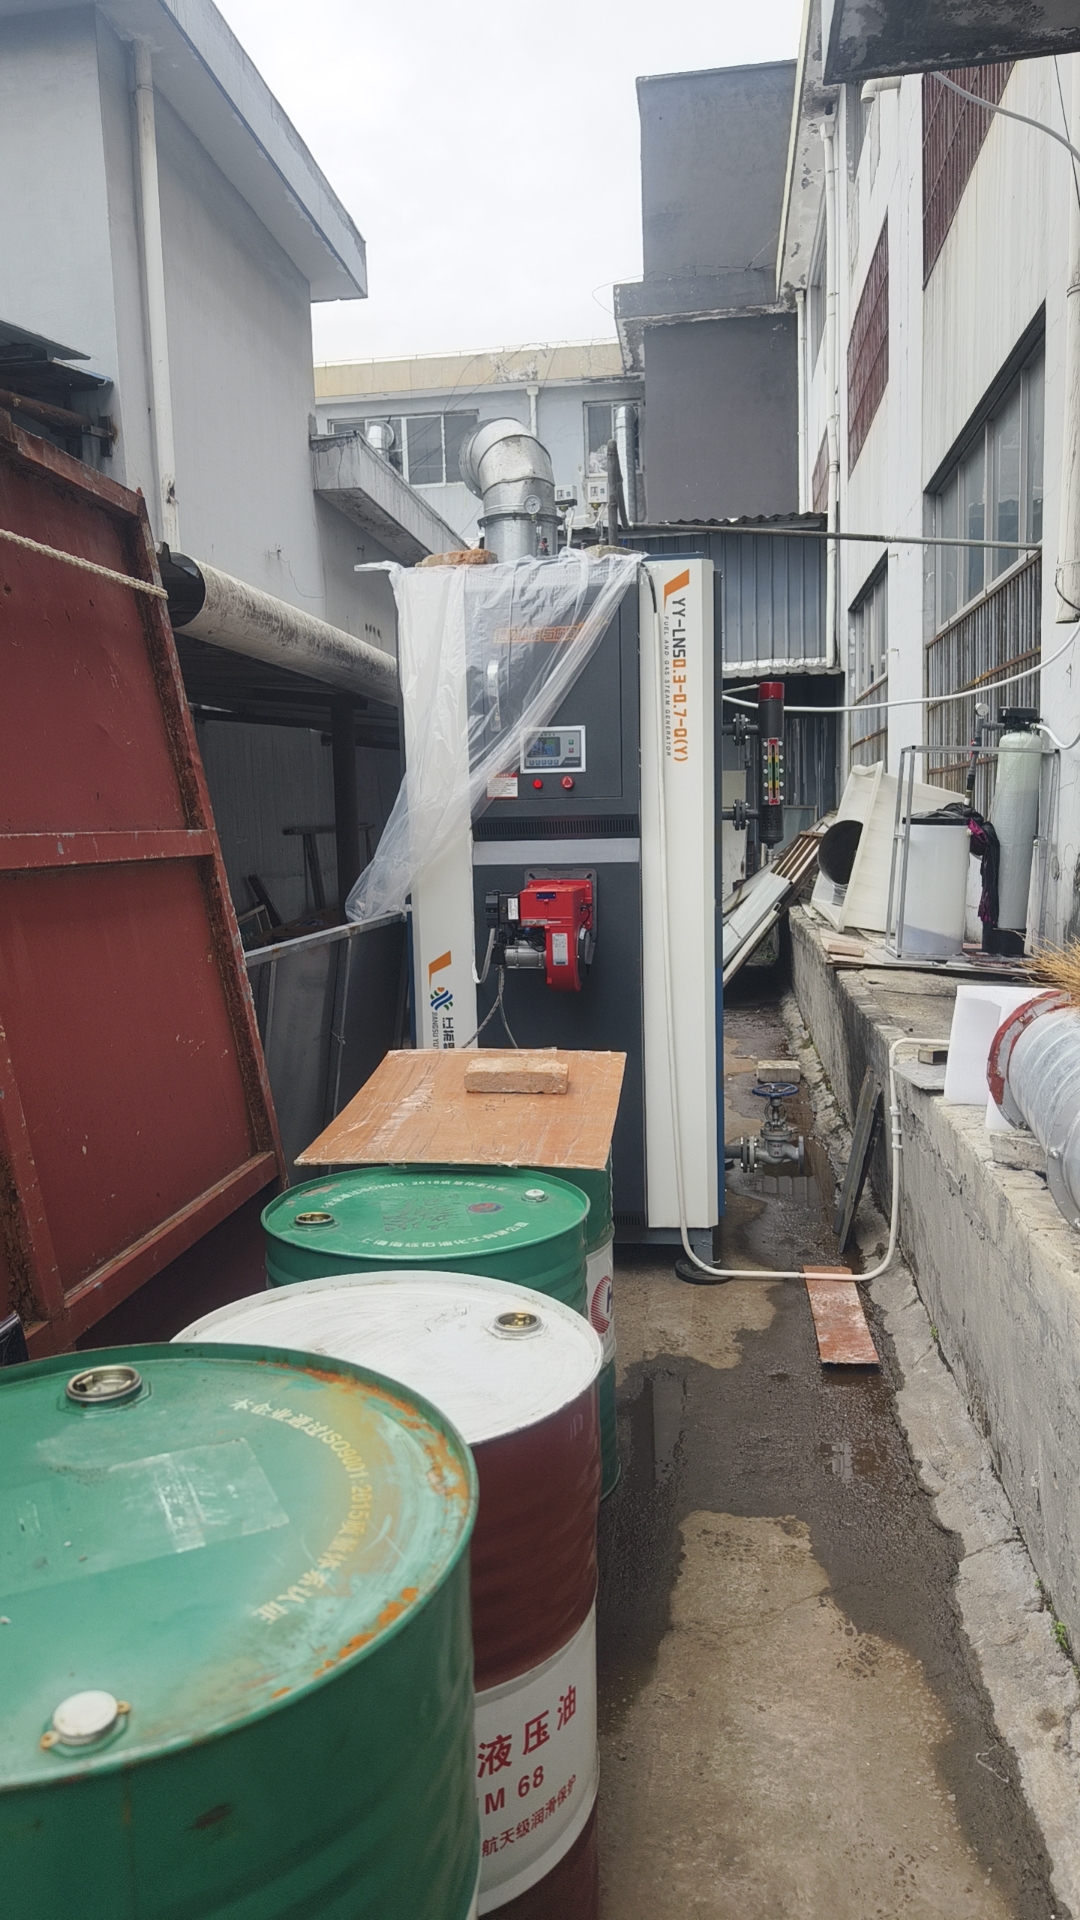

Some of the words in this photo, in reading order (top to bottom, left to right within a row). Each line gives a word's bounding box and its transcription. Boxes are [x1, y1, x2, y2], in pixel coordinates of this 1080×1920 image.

[431, 1011, 439, 1038] JIANGSU
[477, 1684, 577, 1778] 液压油
[476, 1786, 505, 1816] M
[517, 1765, 544, 1798] 68
[481, 1774, 577, 1858] 航天级润滑保护
